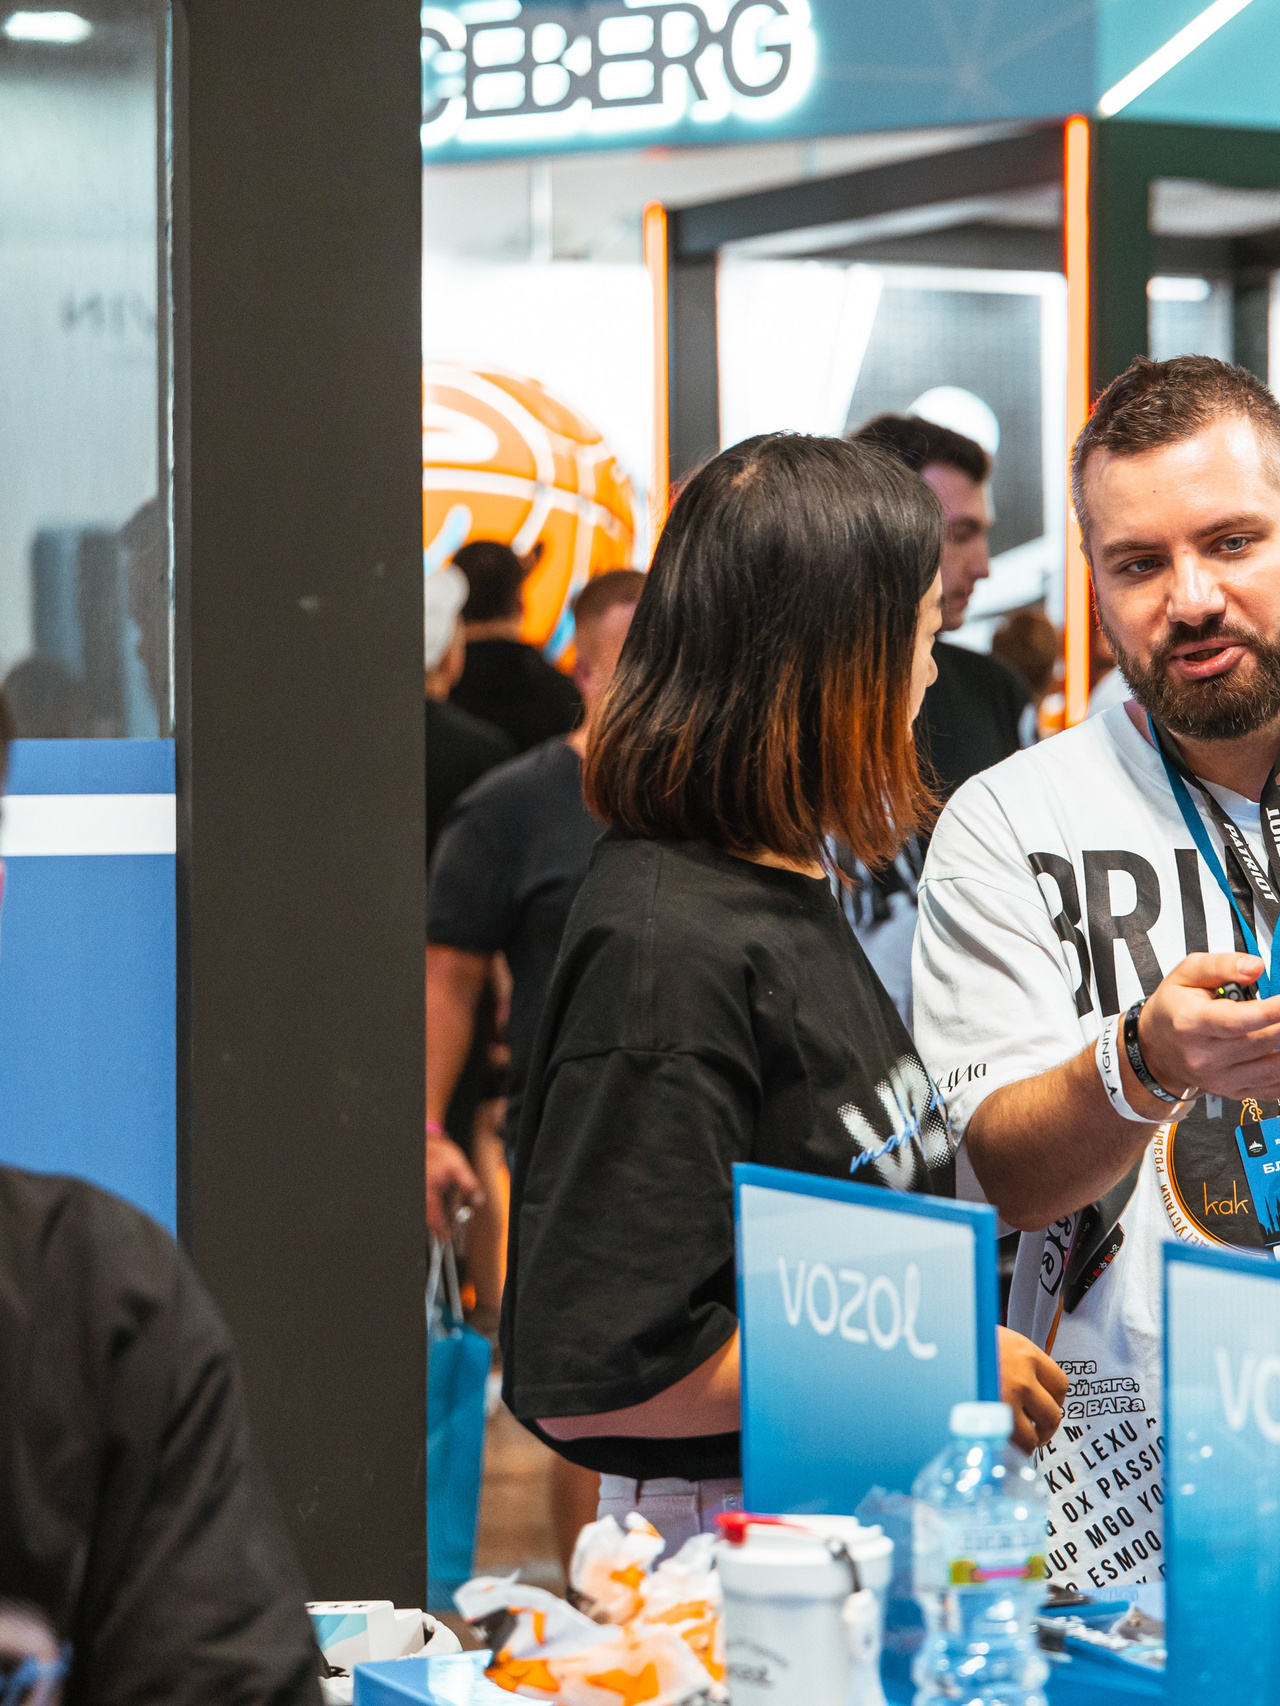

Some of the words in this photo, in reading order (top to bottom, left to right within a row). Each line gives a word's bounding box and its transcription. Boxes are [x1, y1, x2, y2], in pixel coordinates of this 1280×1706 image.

[1223, 822, 1279, 903] PATRIOT
[1091, 1377, 1140, 1394] тяге,
[1068, 1402, 1085, 1419] 2
[1080, 1420, 1138, 1470] LEXU
[1062, 1491, 1094, 1523] OX
[1085, 1506, 1135, 1549] MGO
[1087, 1529, 1162, 1588] ESMOO
